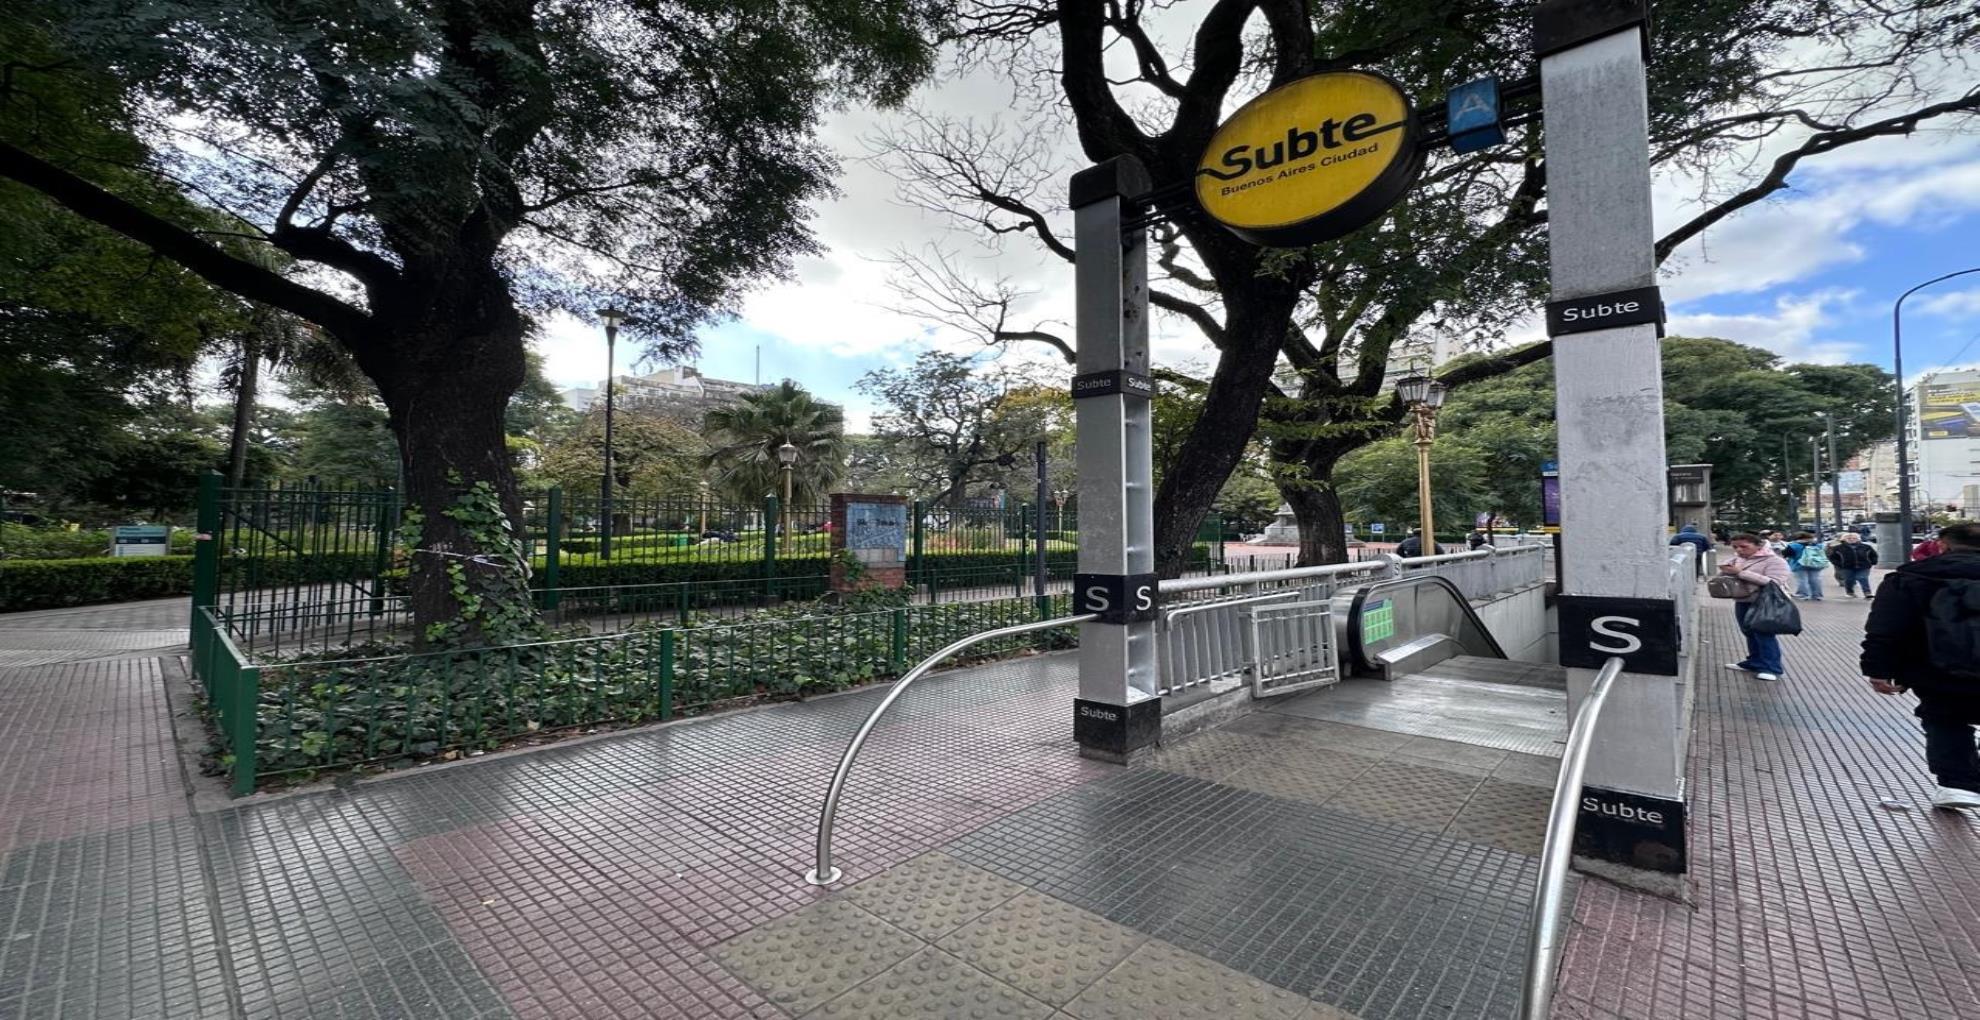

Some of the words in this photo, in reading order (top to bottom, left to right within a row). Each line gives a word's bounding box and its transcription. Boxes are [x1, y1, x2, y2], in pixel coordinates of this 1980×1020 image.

[1453, 92, 1495, 121] A
[1202, 112, 1401, 181] Subte
[1221, 174, 1273, 197] Buenos
[1276, 162, 1316, 180] Aires
[1320, 142, 1379, 168] Ciudad
[1562, 300, 1640, 322] Subte
[1077, 378, 1112, 391] Subte
[1127, 377, 1152, 391] Subte
[1085, 585, 1110, 612] S
[1135, 585, 1152, 611] S
[1589, 615, 1642, 654] S
[1080, 705, 1118, 721] Subte
[1582, 797, 1664, 824] Subte
